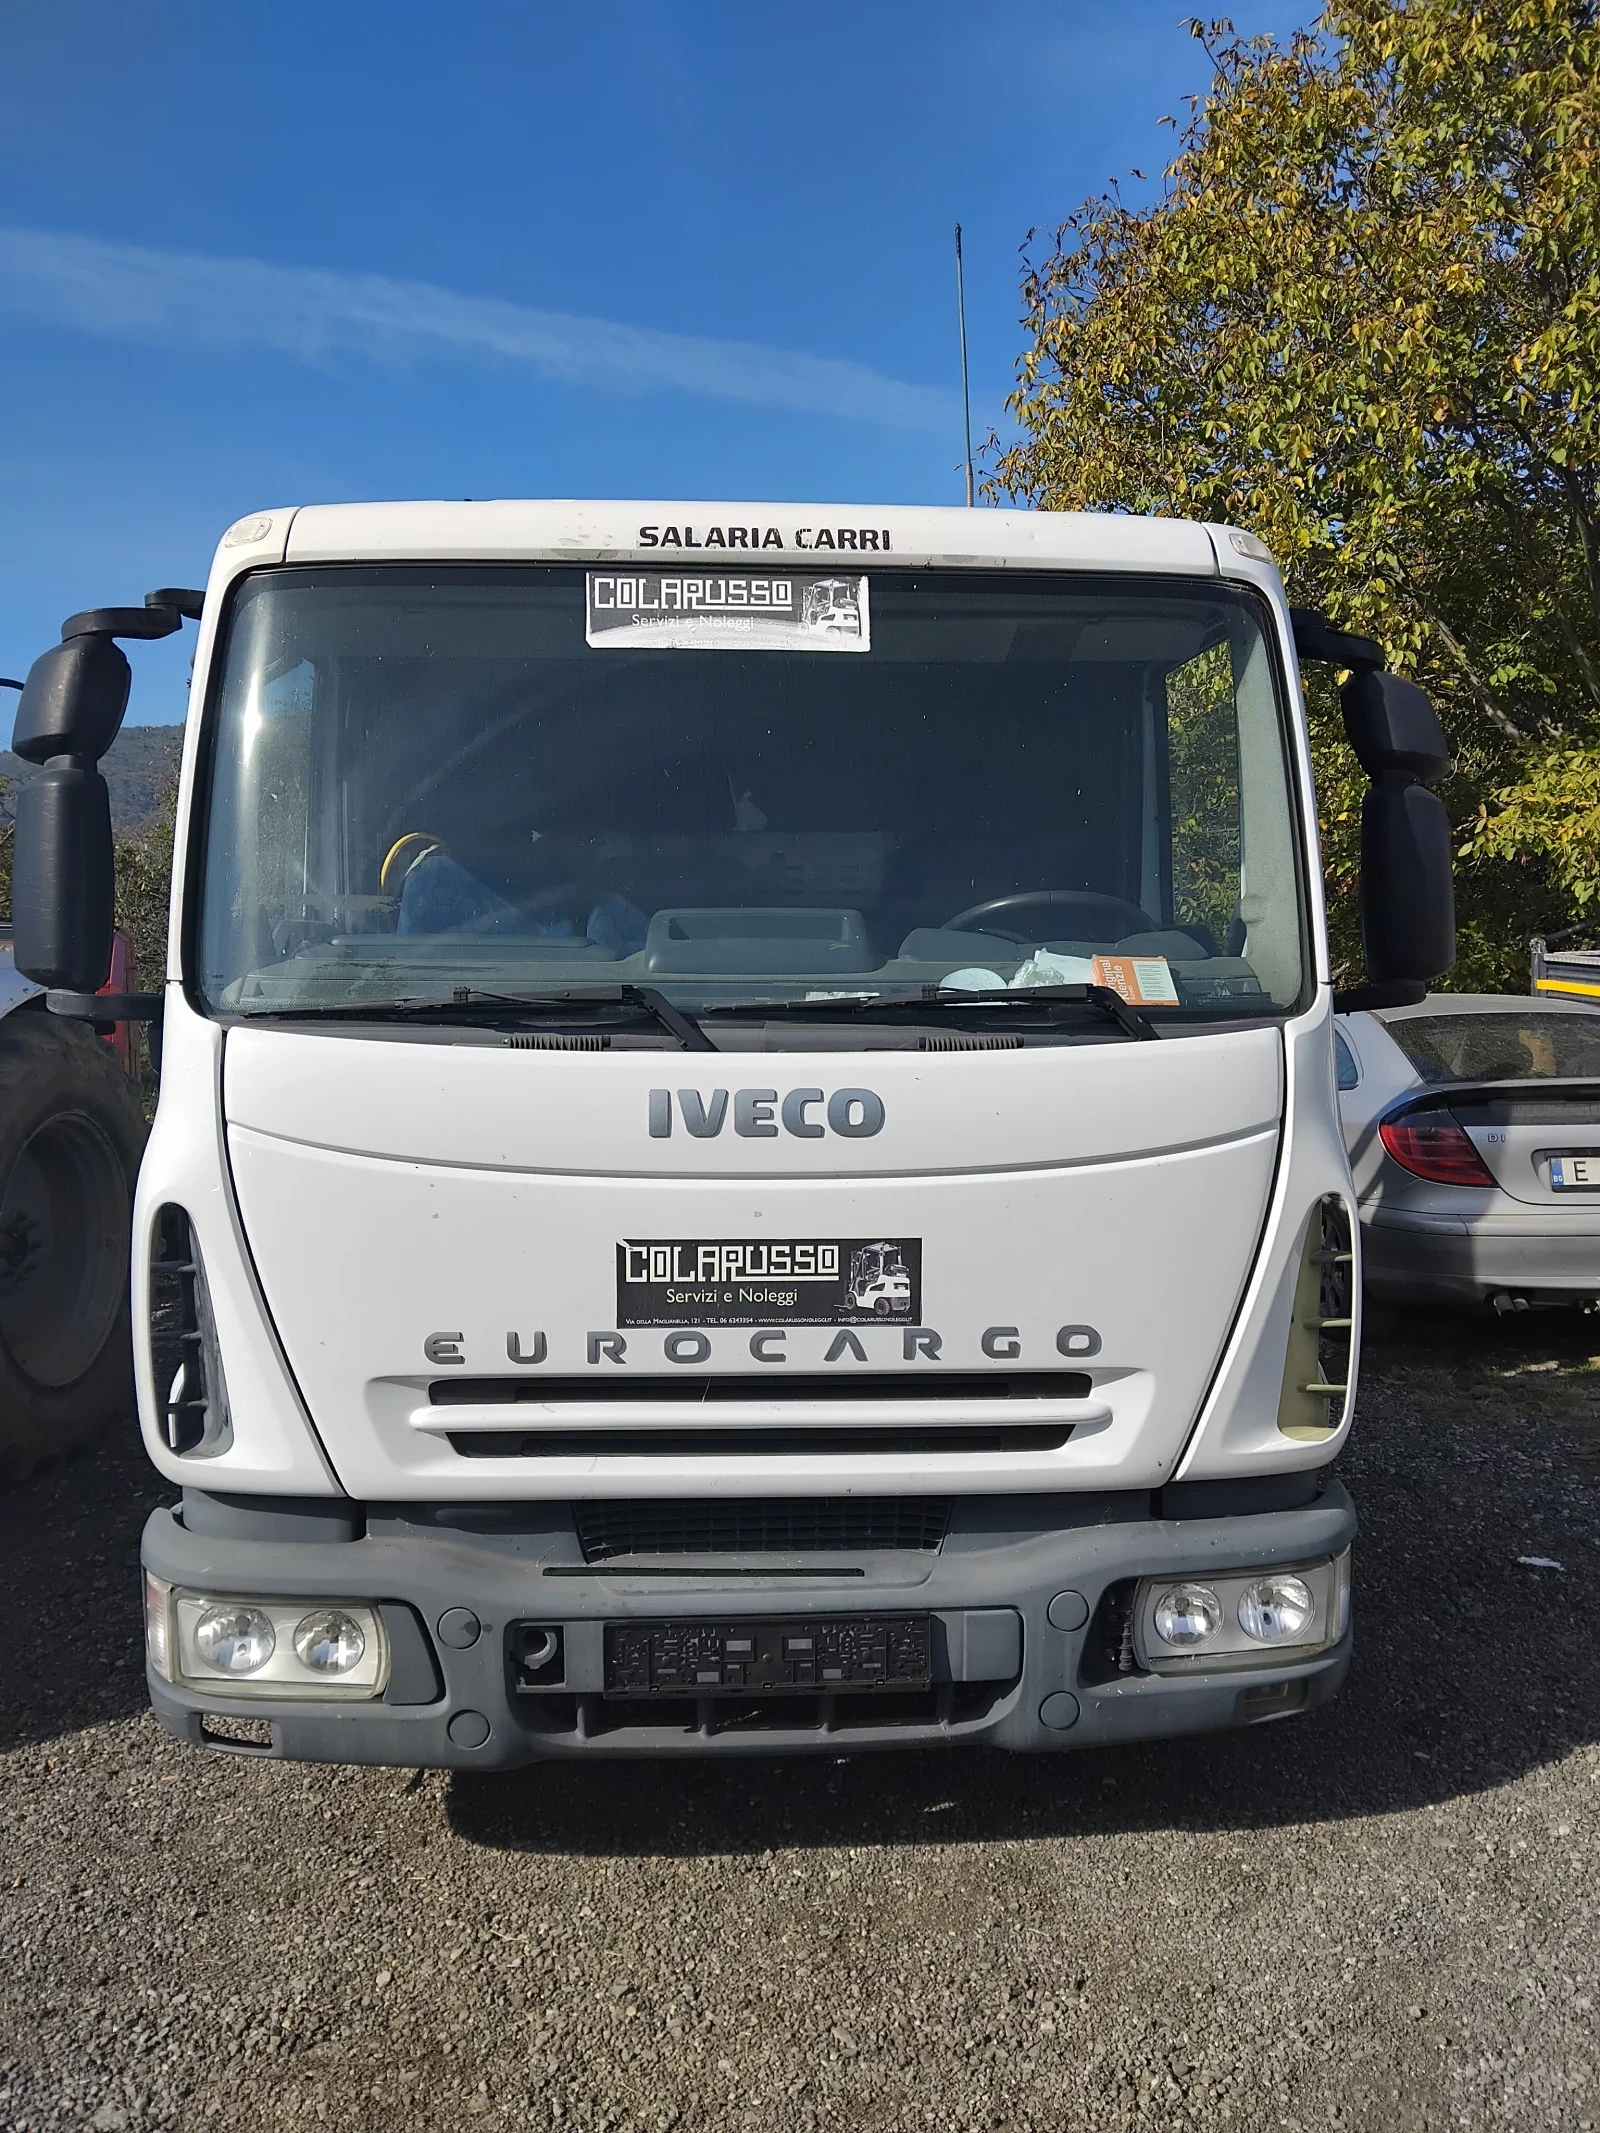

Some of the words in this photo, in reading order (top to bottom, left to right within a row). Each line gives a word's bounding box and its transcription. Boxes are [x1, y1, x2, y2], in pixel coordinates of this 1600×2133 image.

[638, 525, 784, 549] SALARIA
[795, 527, 891, 551] CARRI
[594, 577, 793, 612] COLARUSSO
[631, 613, 679, 627] Servizi
[685, 618, 694, 627] e
[700, 615, 755, 632] Noleggi
[1099, 959, 1117, 989] riginal
[648, 1087, 885, 1139] IVECO
[1553, 1175, 1563, 1183] BG
[1573, 1161, 1589, 1182] E
[625, 1245, 839, 1283] COLARUSSO
[666, 1288, 717, 1303] Servizi
[723, 1292, 733, 1303] e
[739, 1288, 798, 1306] Noleggi
[424, 1324, 1103, 1365] EUROCARGO
